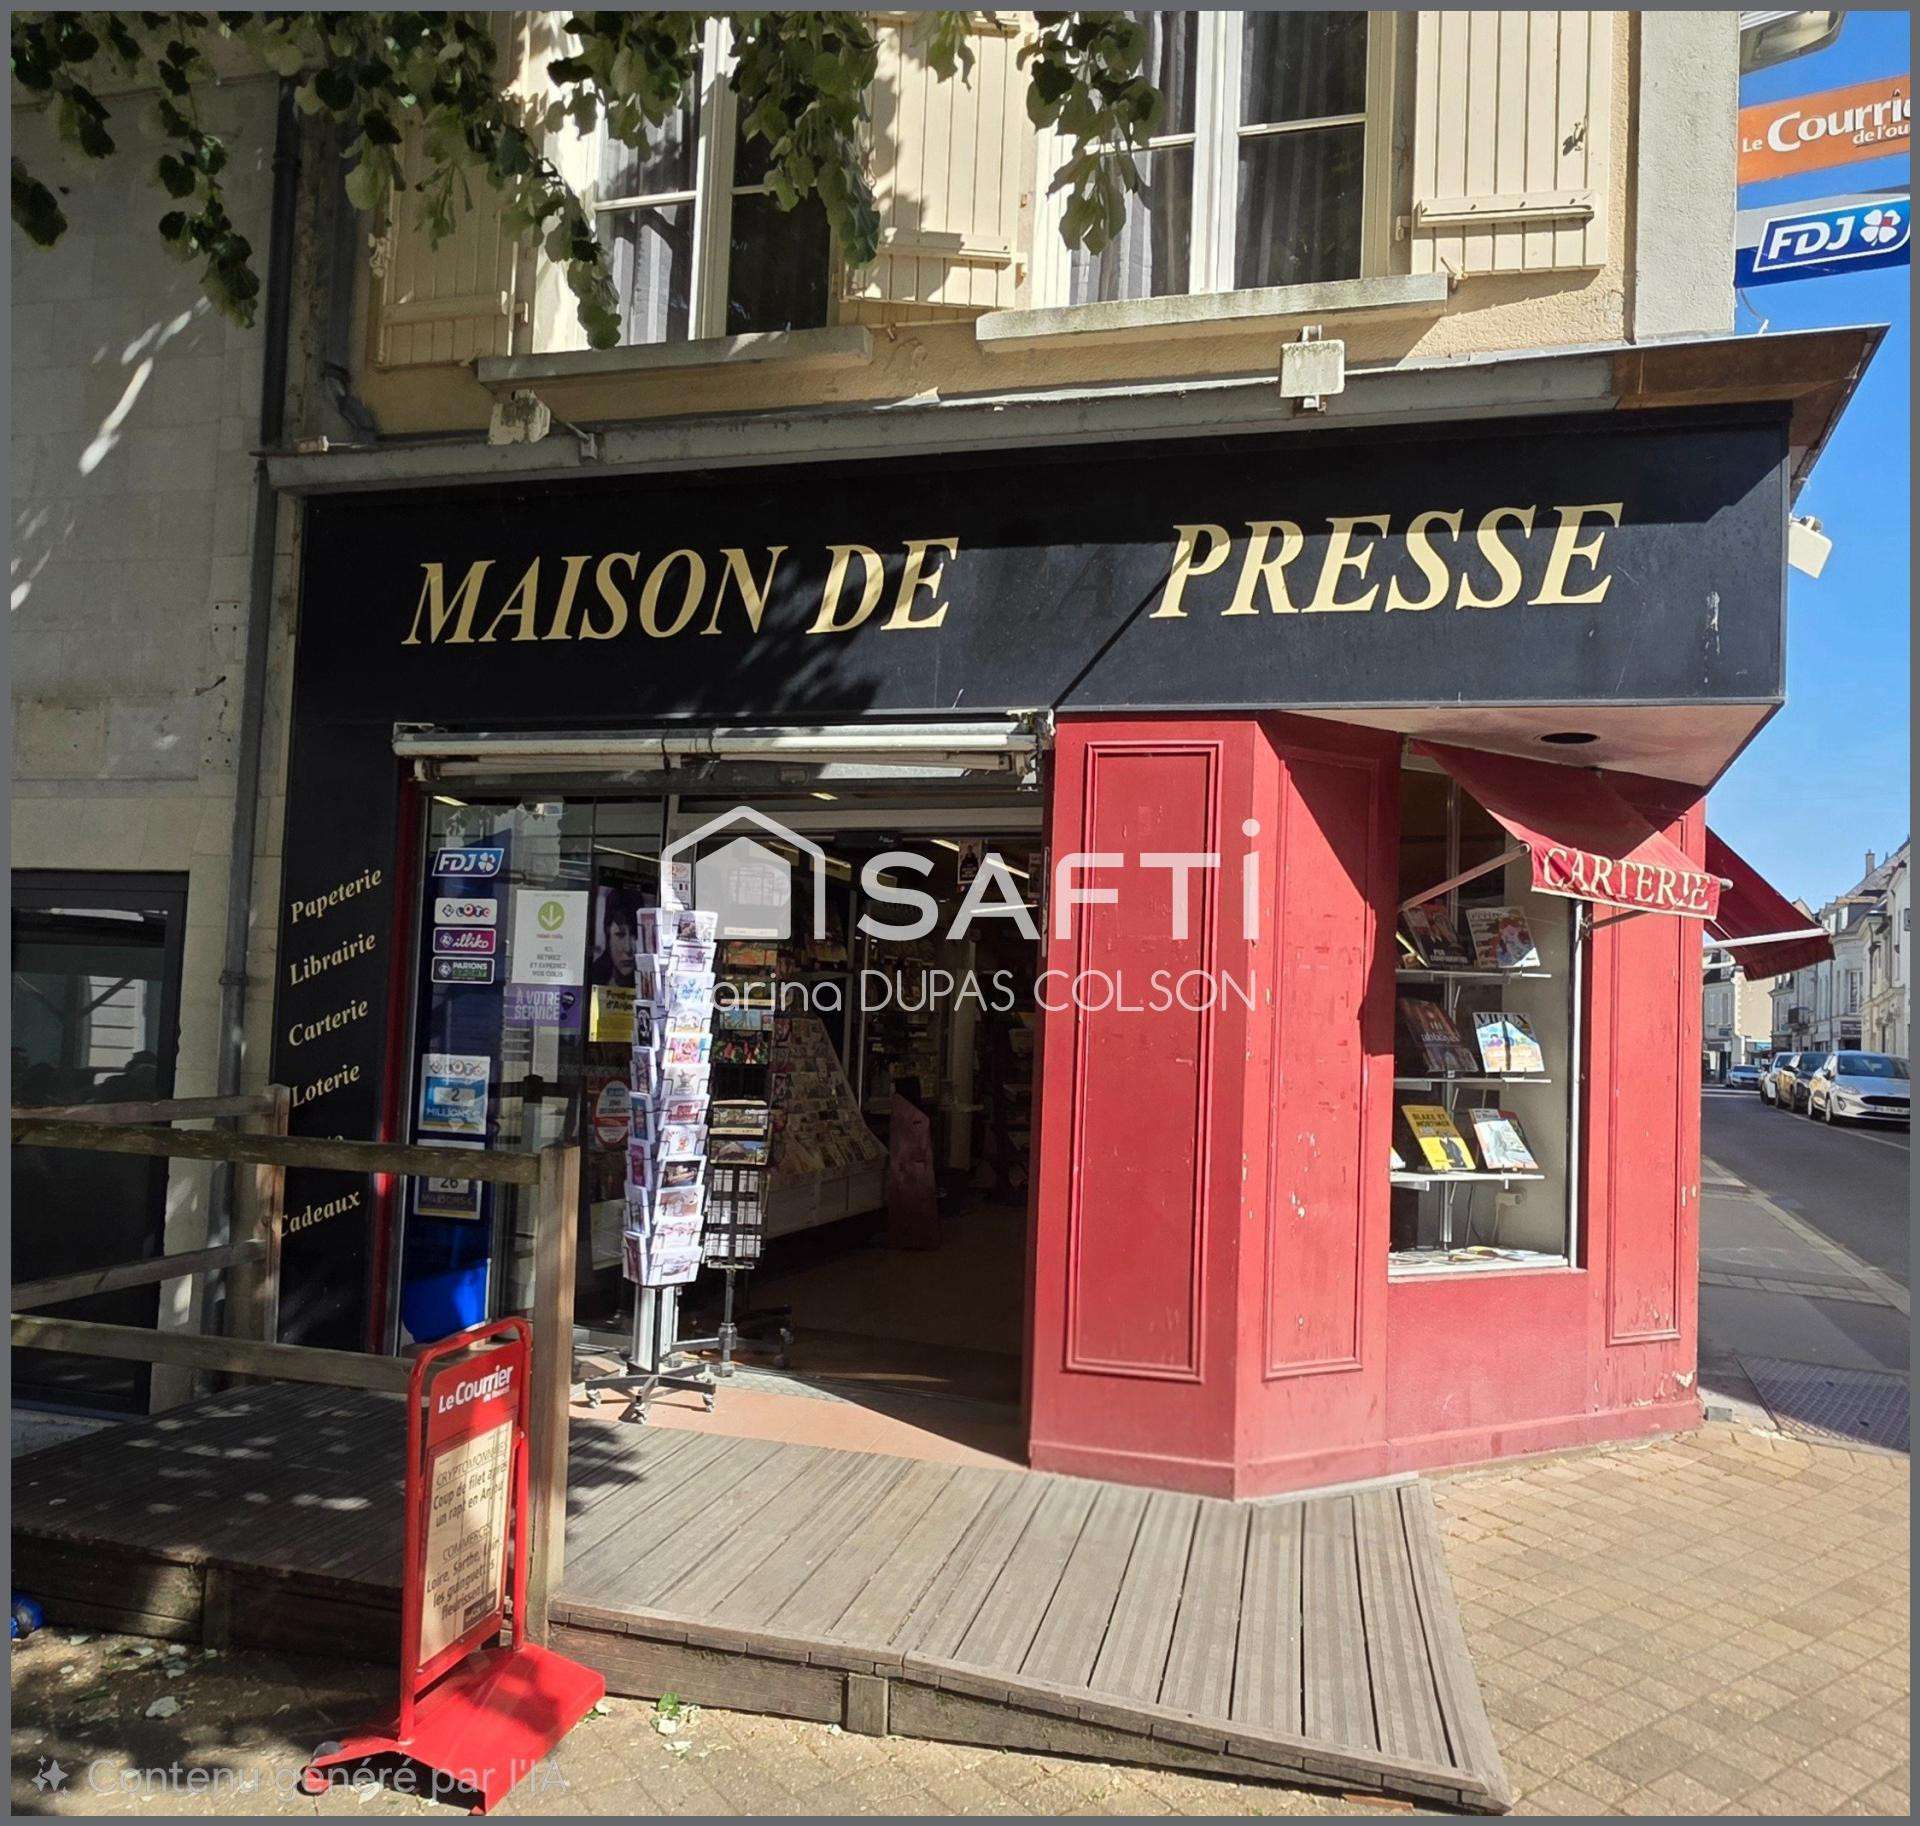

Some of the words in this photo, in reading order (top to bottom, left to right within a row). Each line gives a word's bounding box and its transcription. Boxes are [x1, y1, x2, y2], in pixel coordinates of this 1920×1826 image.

[1742, 138, 1762, 153] Le
[1852, 130, 1875, 145] de
[1768, 215, 1855, 260] FDJ
[401, 545, 788, 645] MAISON
[806, 537, 959, 634] DE
[1149, 502, 1623, 618] PRESSE
[438, 853, 478, 872] FDJ
[1543, 847, 1710, 910] CARTERIE
[290, 869, 383, 924] Papeterie
[452, 933, 490, 949] illiko
[289, 933, 377, 987] Librairie
[514, 1005, 560, 1020] SERVICE
[526, 990, 560, 1005] VOTRE
[288, 1000, 369, 1046] Carterie
[291, 1064, 361, 1107] Loterie
[450, 1088, 460, 1102] 2
[438, 1394, 456, 1414] Le
[455, 1364, 514, 1406] Courrier
[469, 1472, 486, 1489] filet
